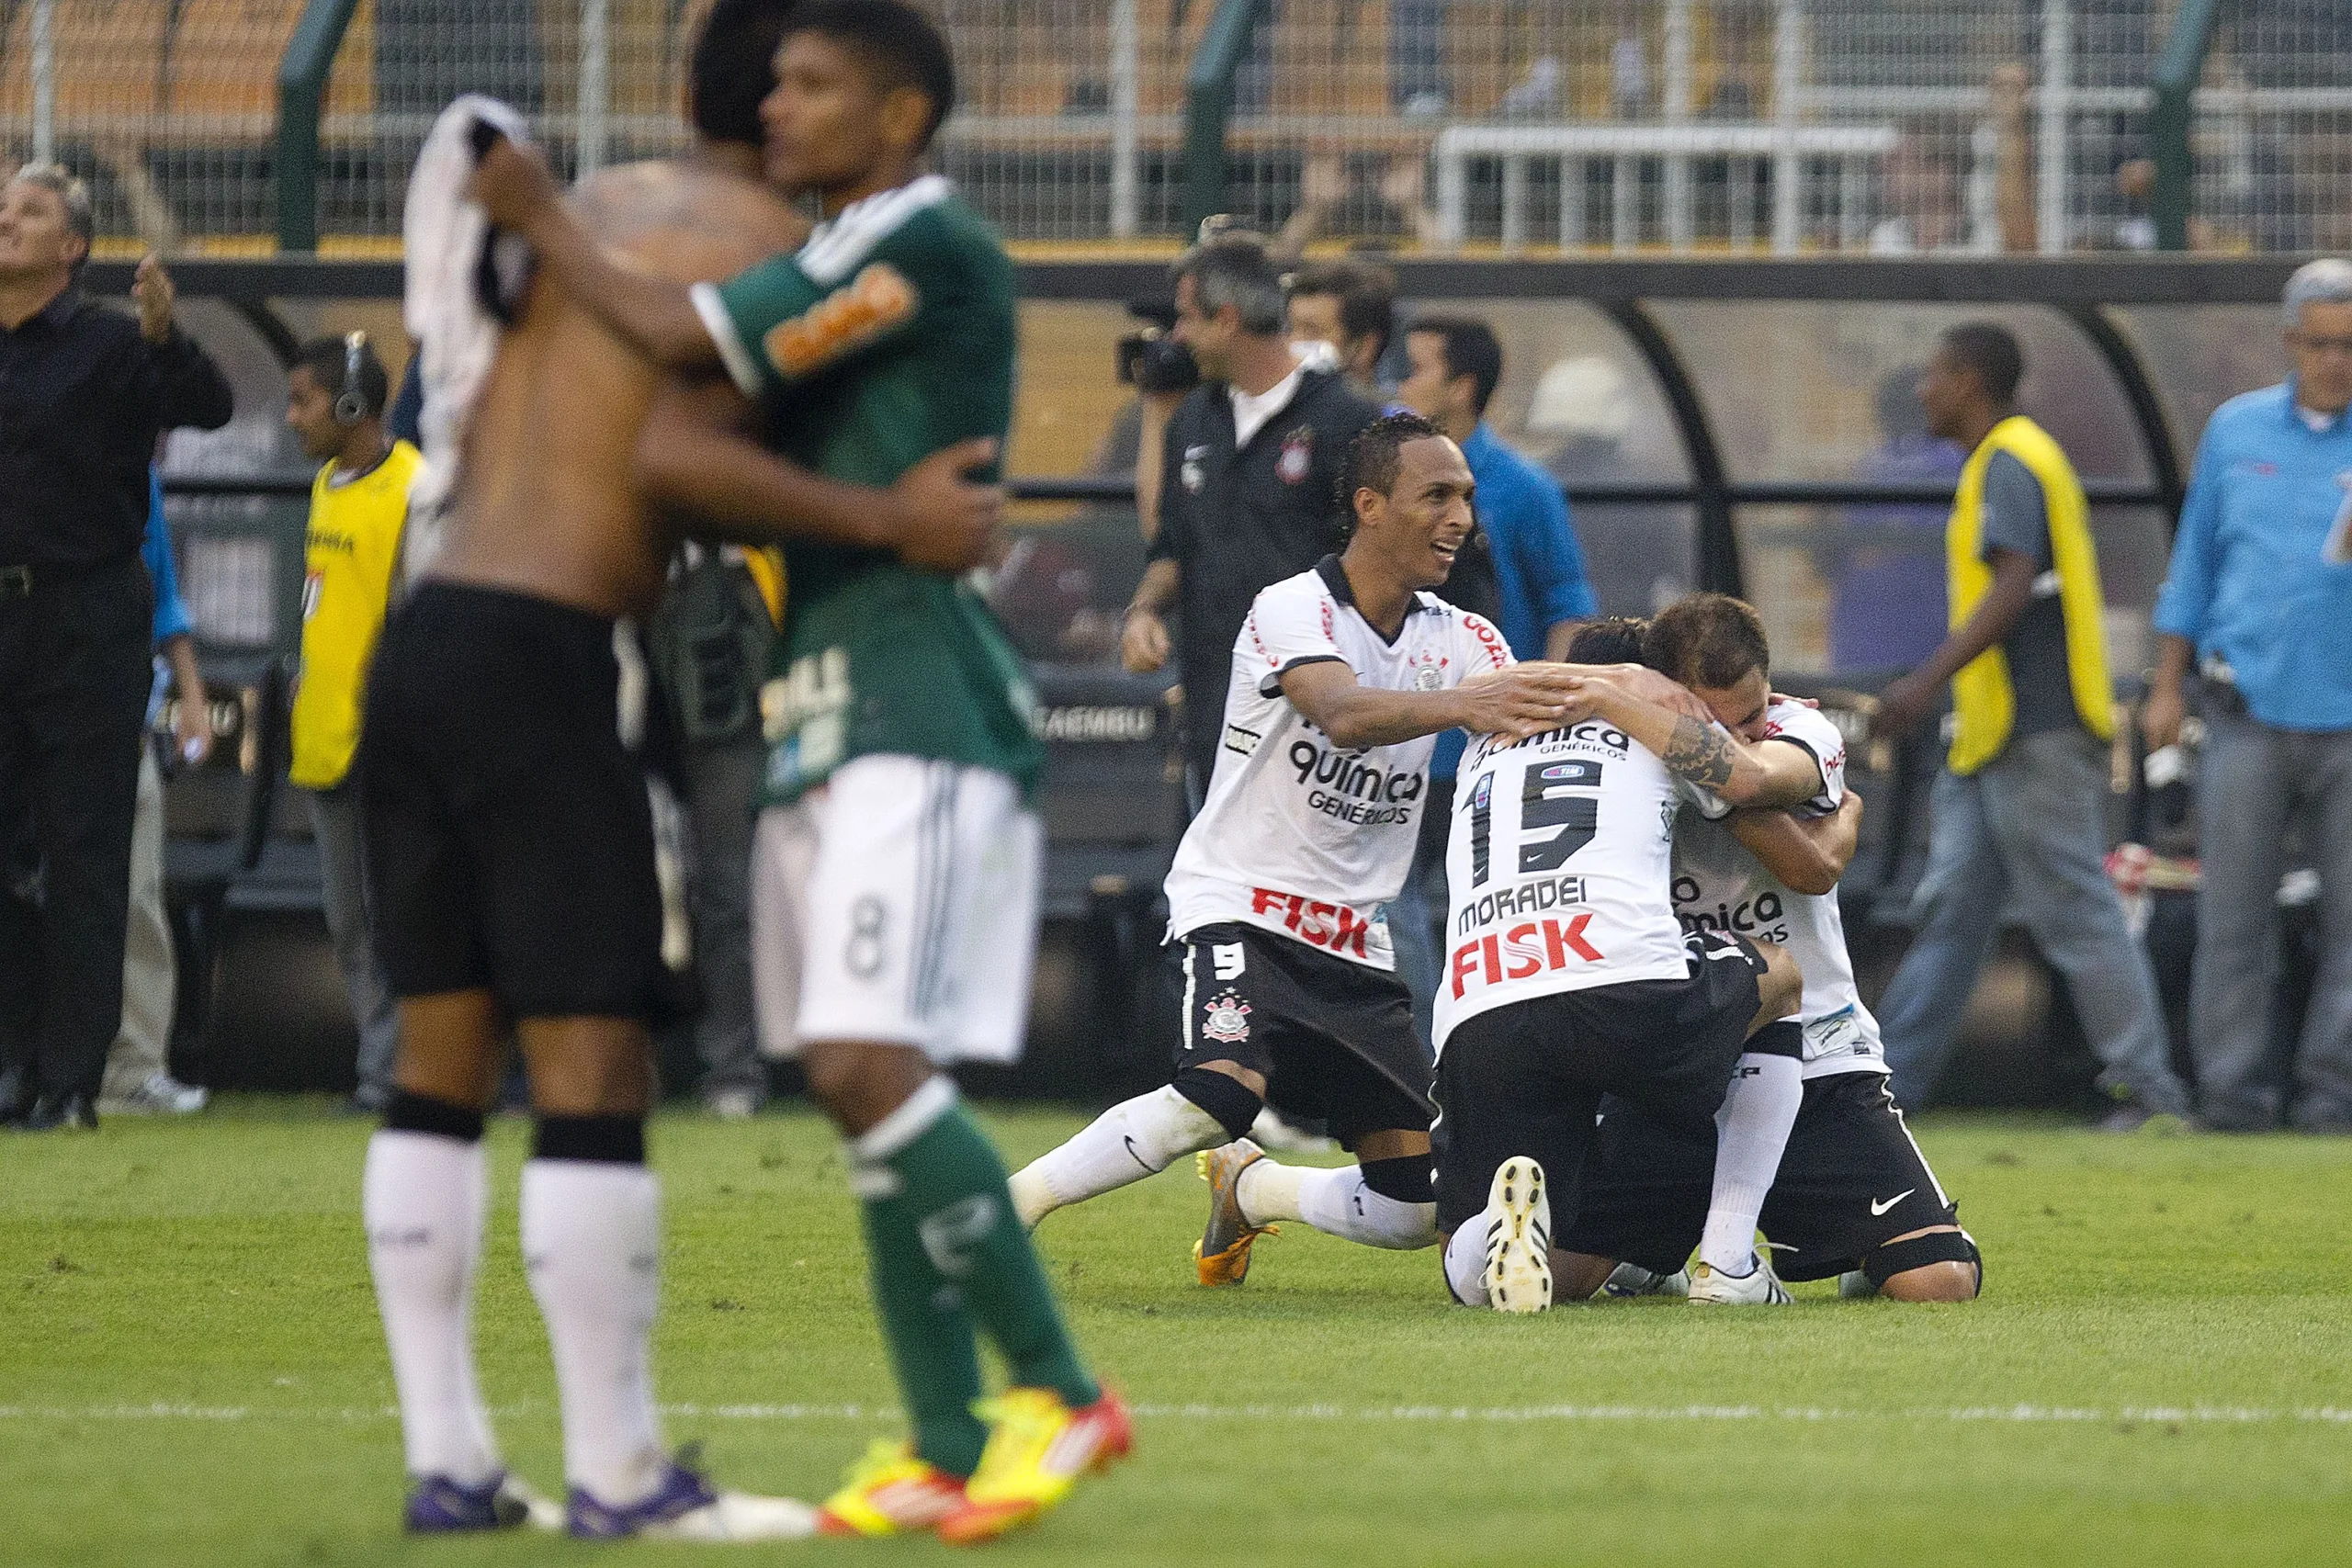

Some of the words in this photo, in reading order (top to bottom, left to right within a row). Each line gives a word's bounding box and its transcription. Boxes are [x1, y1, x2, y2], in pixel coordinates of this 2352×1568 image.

[1539, 741, 1627, 761] GENÉRICOS
[1459, 759, 1603, 888] 15
[842, 890, 889, 985] 8
[1250, 886, 1367, 959] FISK
[1458, 876, 1587, 937] MORADEI
[1212, 942, 1246, 981] 9
[1452, 913, 1605, 1001] FISK
